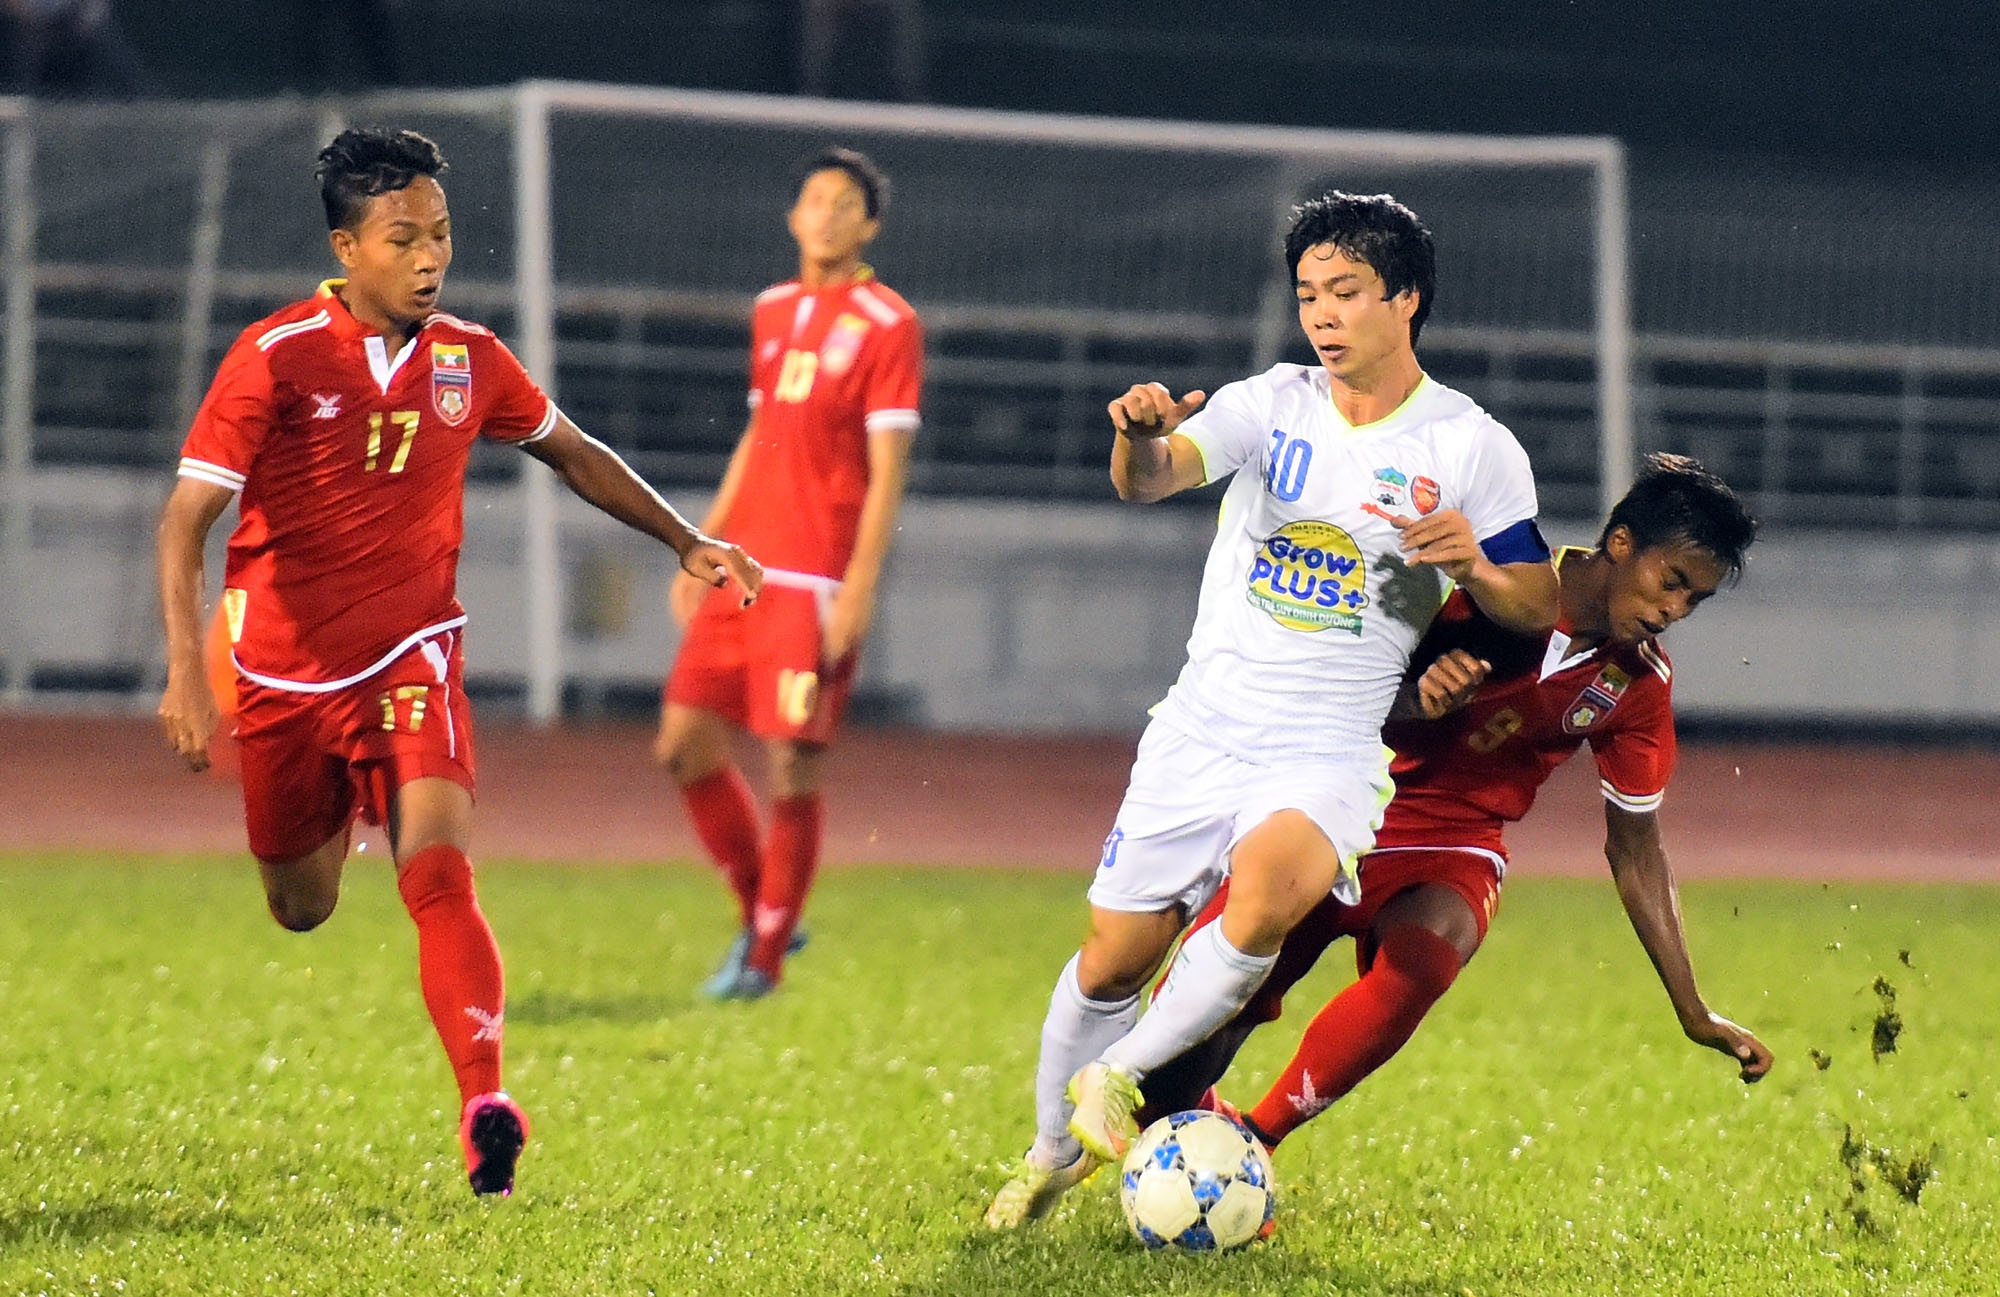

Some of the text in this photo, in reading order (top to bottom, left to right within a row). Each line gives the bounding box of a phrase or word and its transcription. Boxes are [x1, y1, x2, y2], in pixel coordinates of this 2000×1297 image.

[365, 411, 420, 473] 17
[1267, 428, 1313, 502] 10
[1267, 535, 1356, 577] Grow
[1250, 557, 1364, 608] PLUS+
[379, 686, 428, 732] 17
